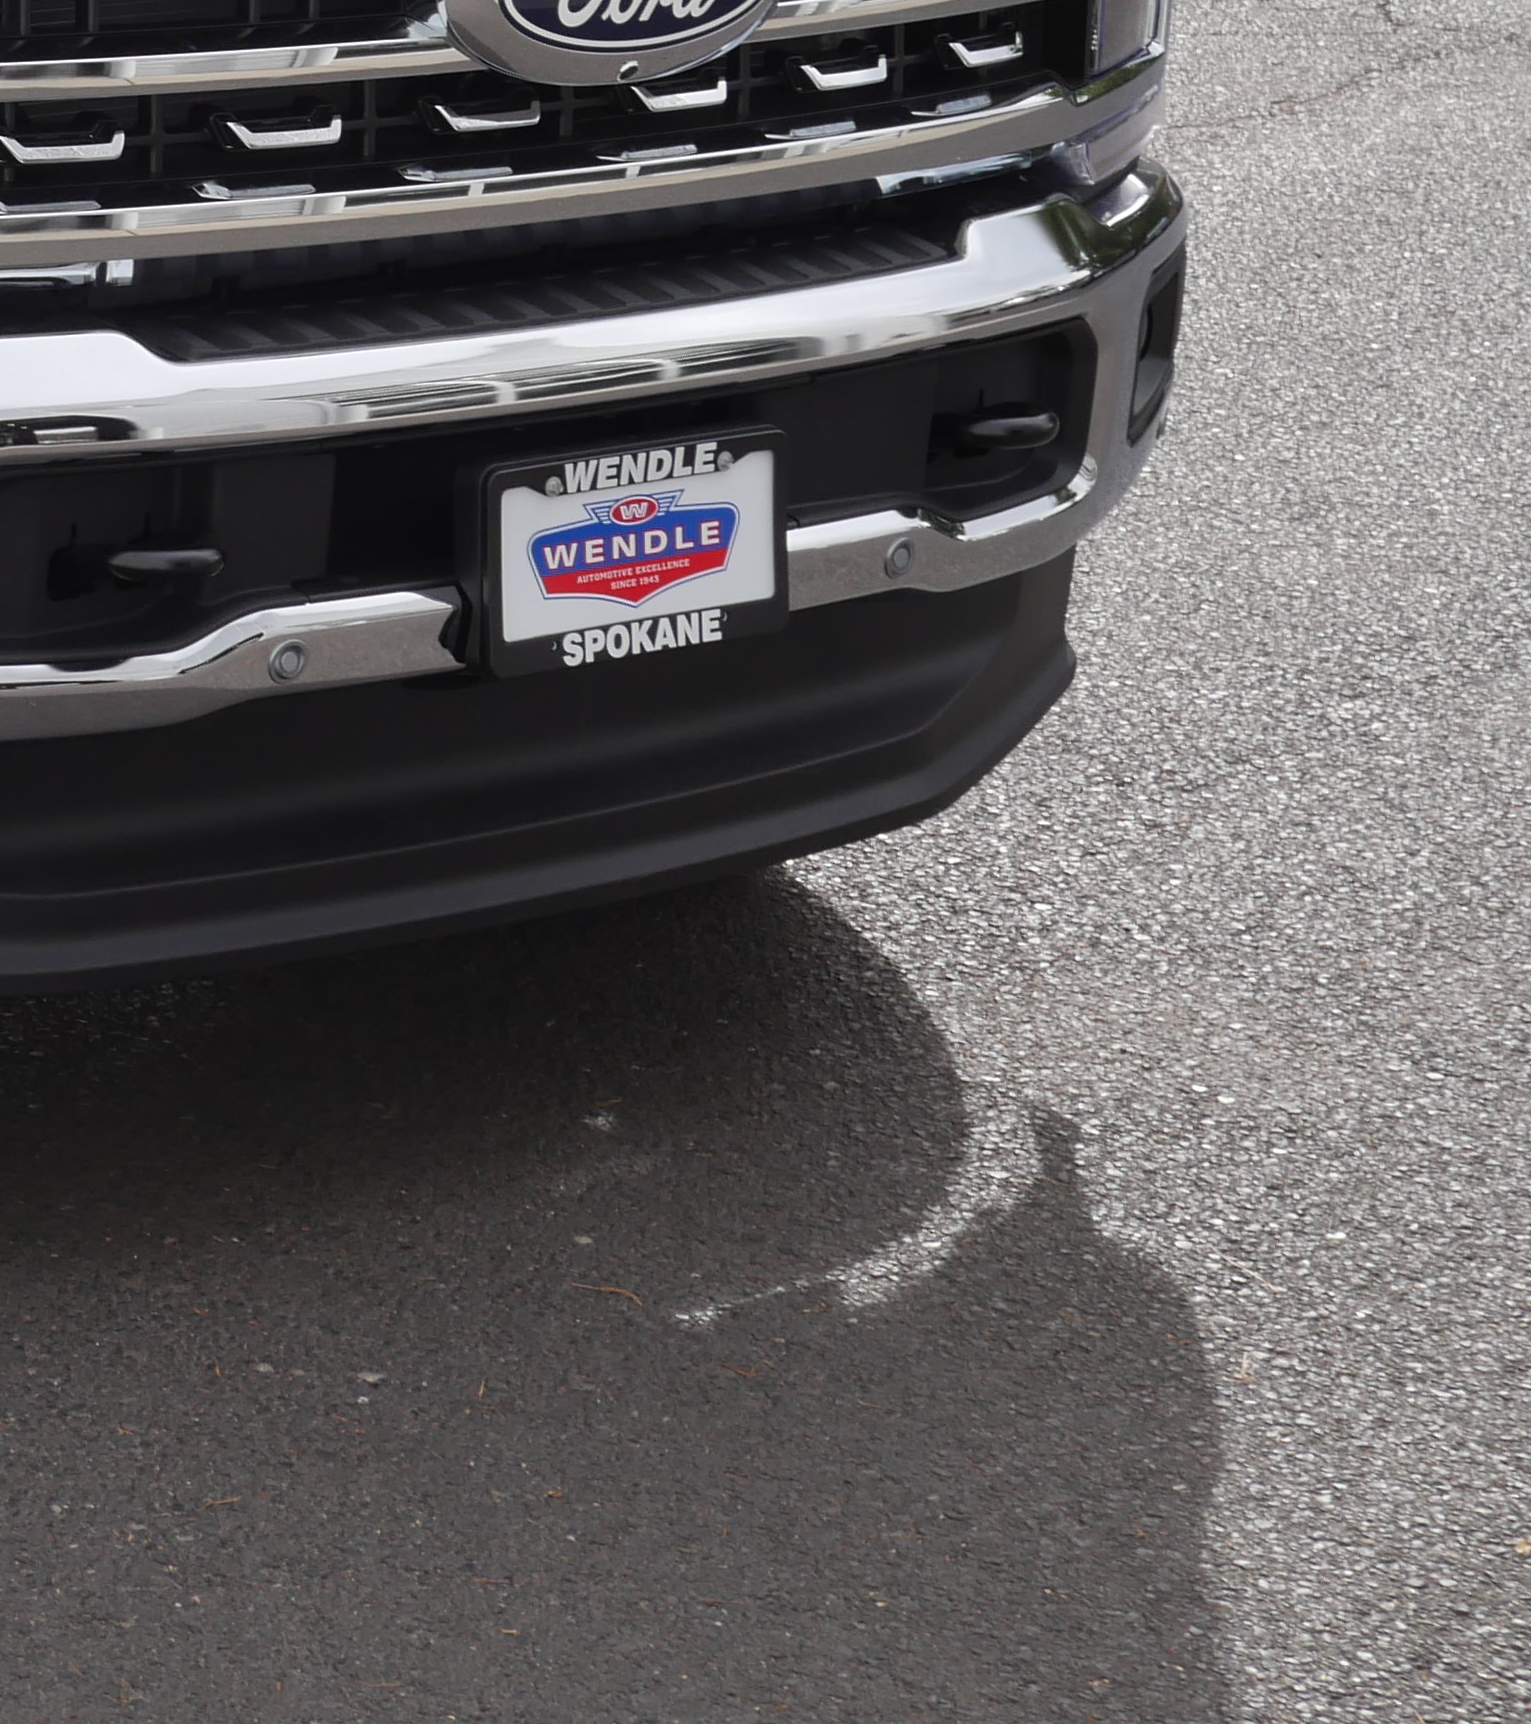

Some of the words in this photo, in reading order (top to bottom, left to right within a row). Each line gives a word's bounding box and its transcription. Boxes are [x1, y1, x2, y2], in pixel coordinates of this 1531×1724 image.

[564, 441, 718, 494] WENDLE
[619, 500, 649, 520] W
[542, 520, 721, 570] WENDLE
[577, 567, 634, 584] AUTOMOTIVE
[635, 558, 690, 576] EXCELLENCE
[610, 578, 637, 590] SINCE
[562, 608, 723, 667] SPOKANE
